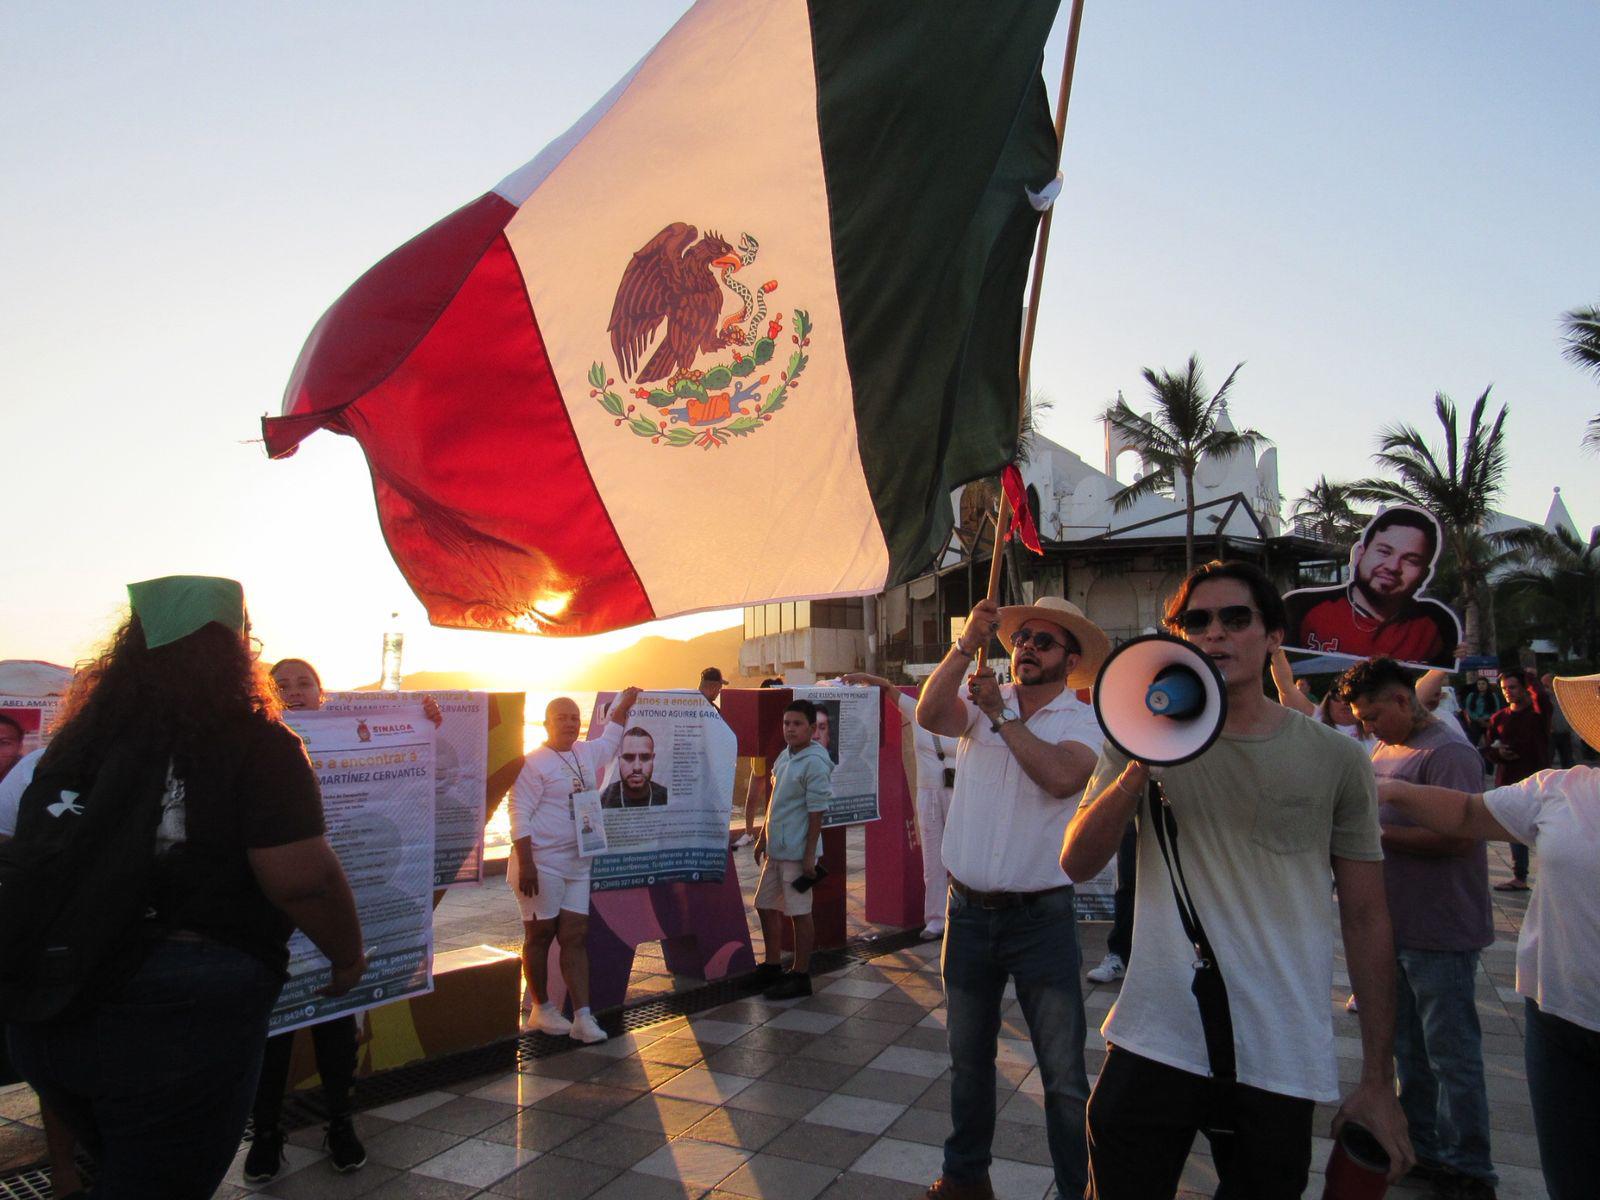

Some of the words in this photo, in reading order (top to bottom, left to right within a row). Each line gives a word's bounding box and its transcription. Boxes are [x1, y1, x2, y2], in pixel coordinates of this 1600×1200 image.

[372, 723, 414, 734] SINALOA
[327, 758, 337, 770] a
[341, 751, 407, 768] encontrar
[409, 751, 418, 763] a
[372, 766, 427, 782] CERVANTES
[361, 971, 380, 983] muy
